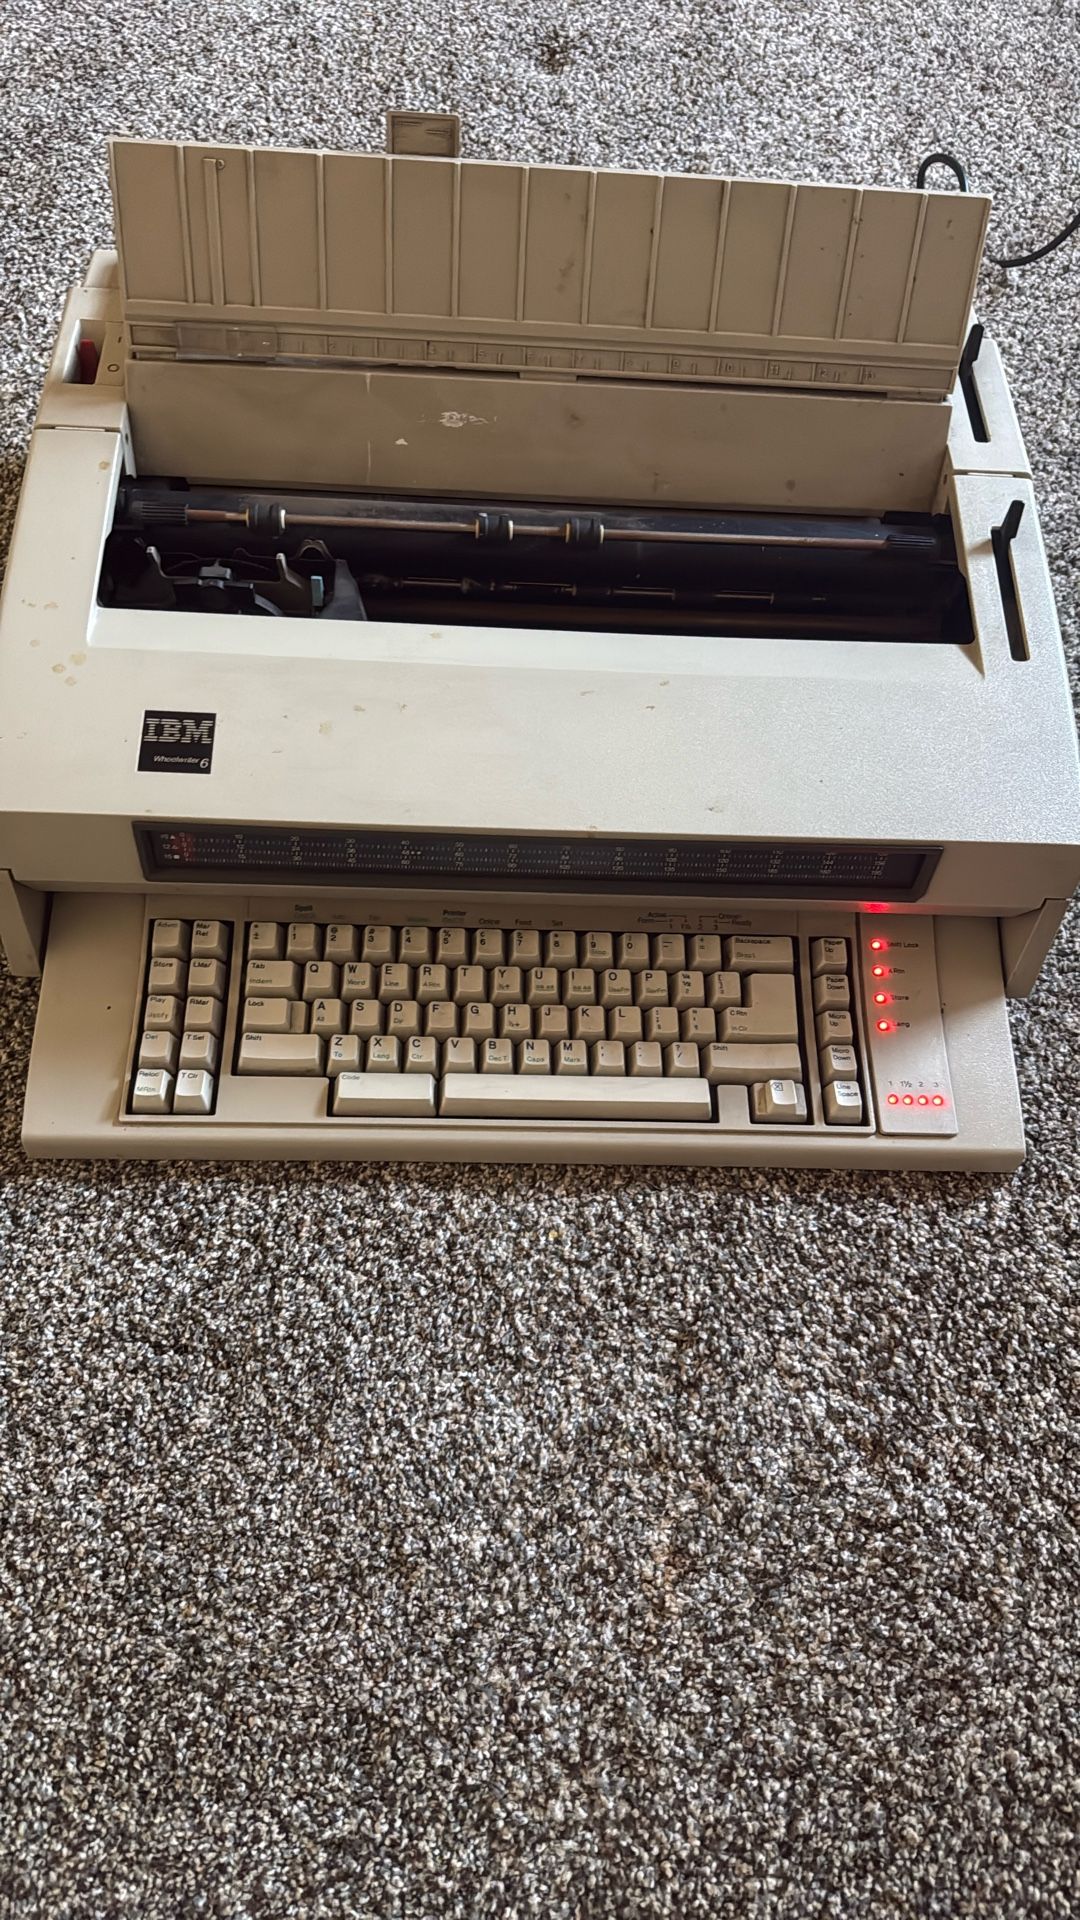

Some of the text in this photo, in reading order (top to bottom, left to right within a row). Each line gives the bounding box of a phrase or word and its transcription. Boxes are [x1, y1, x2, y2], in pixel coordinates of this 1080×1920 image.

[143, 718, 213, 743] IBM
[199, 758, 209, 769] 6
[309, 963, 319, 973] Q
[348, 964, 358, 973] W
[385, 965, 393, 974] E
[423, 966, 432, 976] R
[461, 967, 469, 977] T
[498, 969, 506, 978] Y
[535, 970, 543, 980] U
[608, 972, 618, 981] O
[645, 973, 653, 981] P
[317, 1001, 326, 1011] A
[356, 1002, 365, 1012] S
[394, 1002, 403, 1012] D
[432, 1004, 439, 1013] F
[470, 1005, 479, 1015] G
[508, 1006, 516, 1015] H
[545, 1008, 551, 1016] J
[581, 1008, 590, 1017] K
[619, 1009, 626, 1017] L
[334, 1037, 343, 1046] Z
[374, 1038, 382, 1047] X
[412, 1039, 421, 1048] C
[451, 1040, 460, 1048] V
[488, 1040, 496, 1049] B
[526, 1041, 534, 1050] N
[563, 1043, 573, 1051] M
